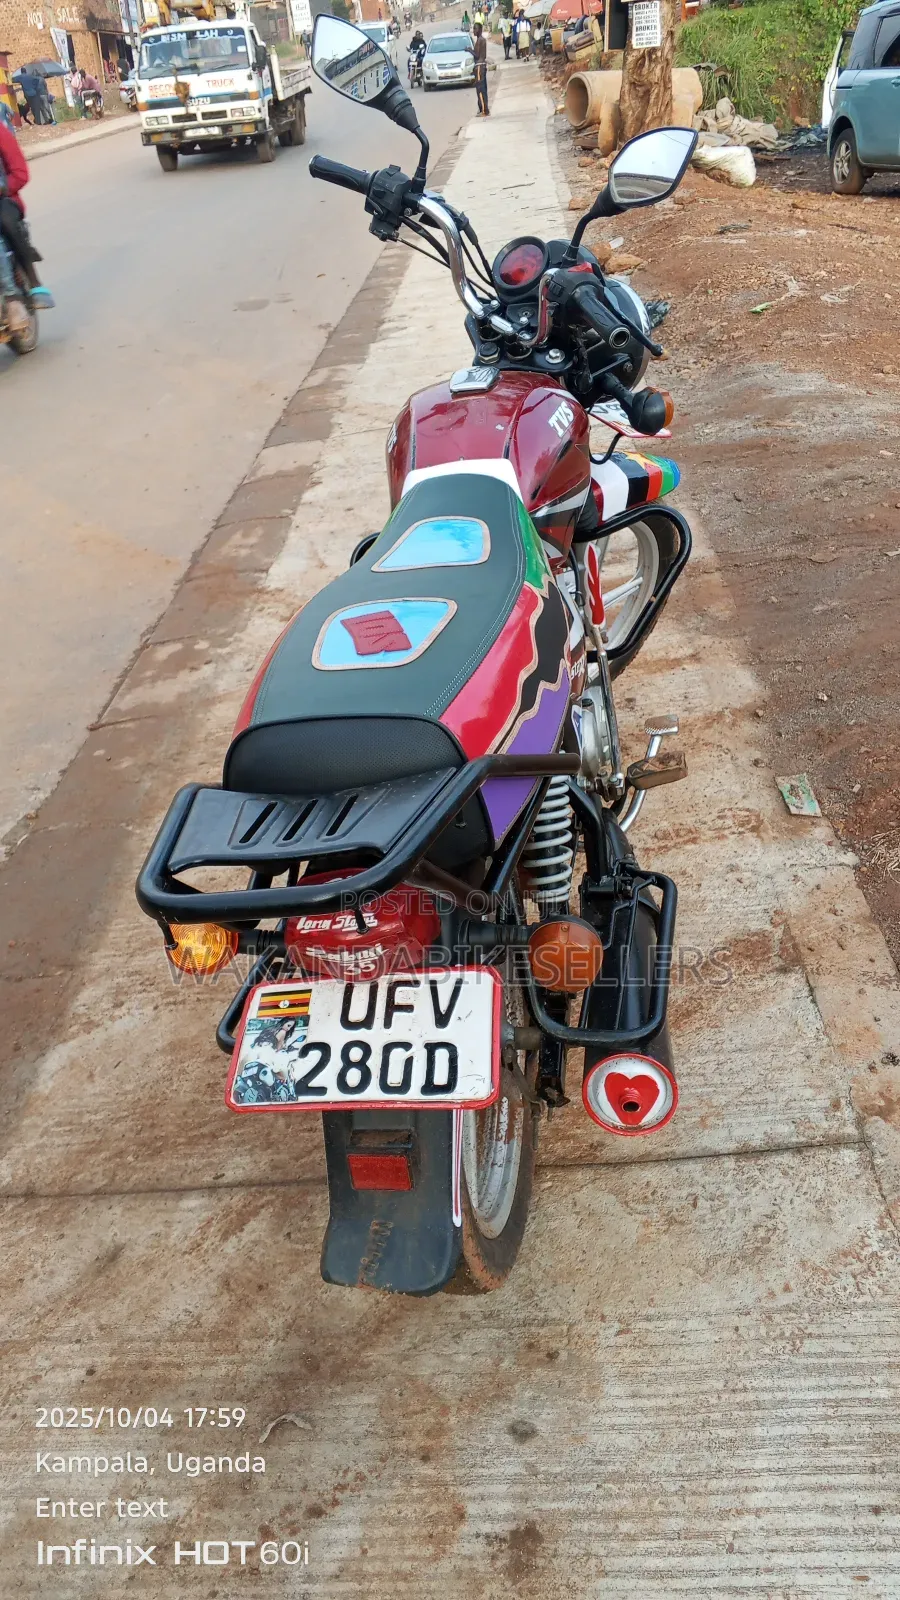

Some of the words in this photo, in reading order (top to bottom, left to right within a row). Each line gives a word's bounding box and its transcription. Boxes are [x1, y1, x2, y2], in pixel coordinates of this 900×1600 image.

[56, 6, 81, 23] SALE
[634, 2, 658, 11] BROKER
[635, 24, 658, 32] BROKER
[206, 78, 235, 88] TRUCK
[186, 96, 211, 106] SUZU
[548, 401, 574, 437] TVS
[332, 912, 379, 932] Stoy
[344, 960, 376, 975] 35
[340, 978, 463, 1031] UFV
[295, 1040, 459, 1096] 280D
